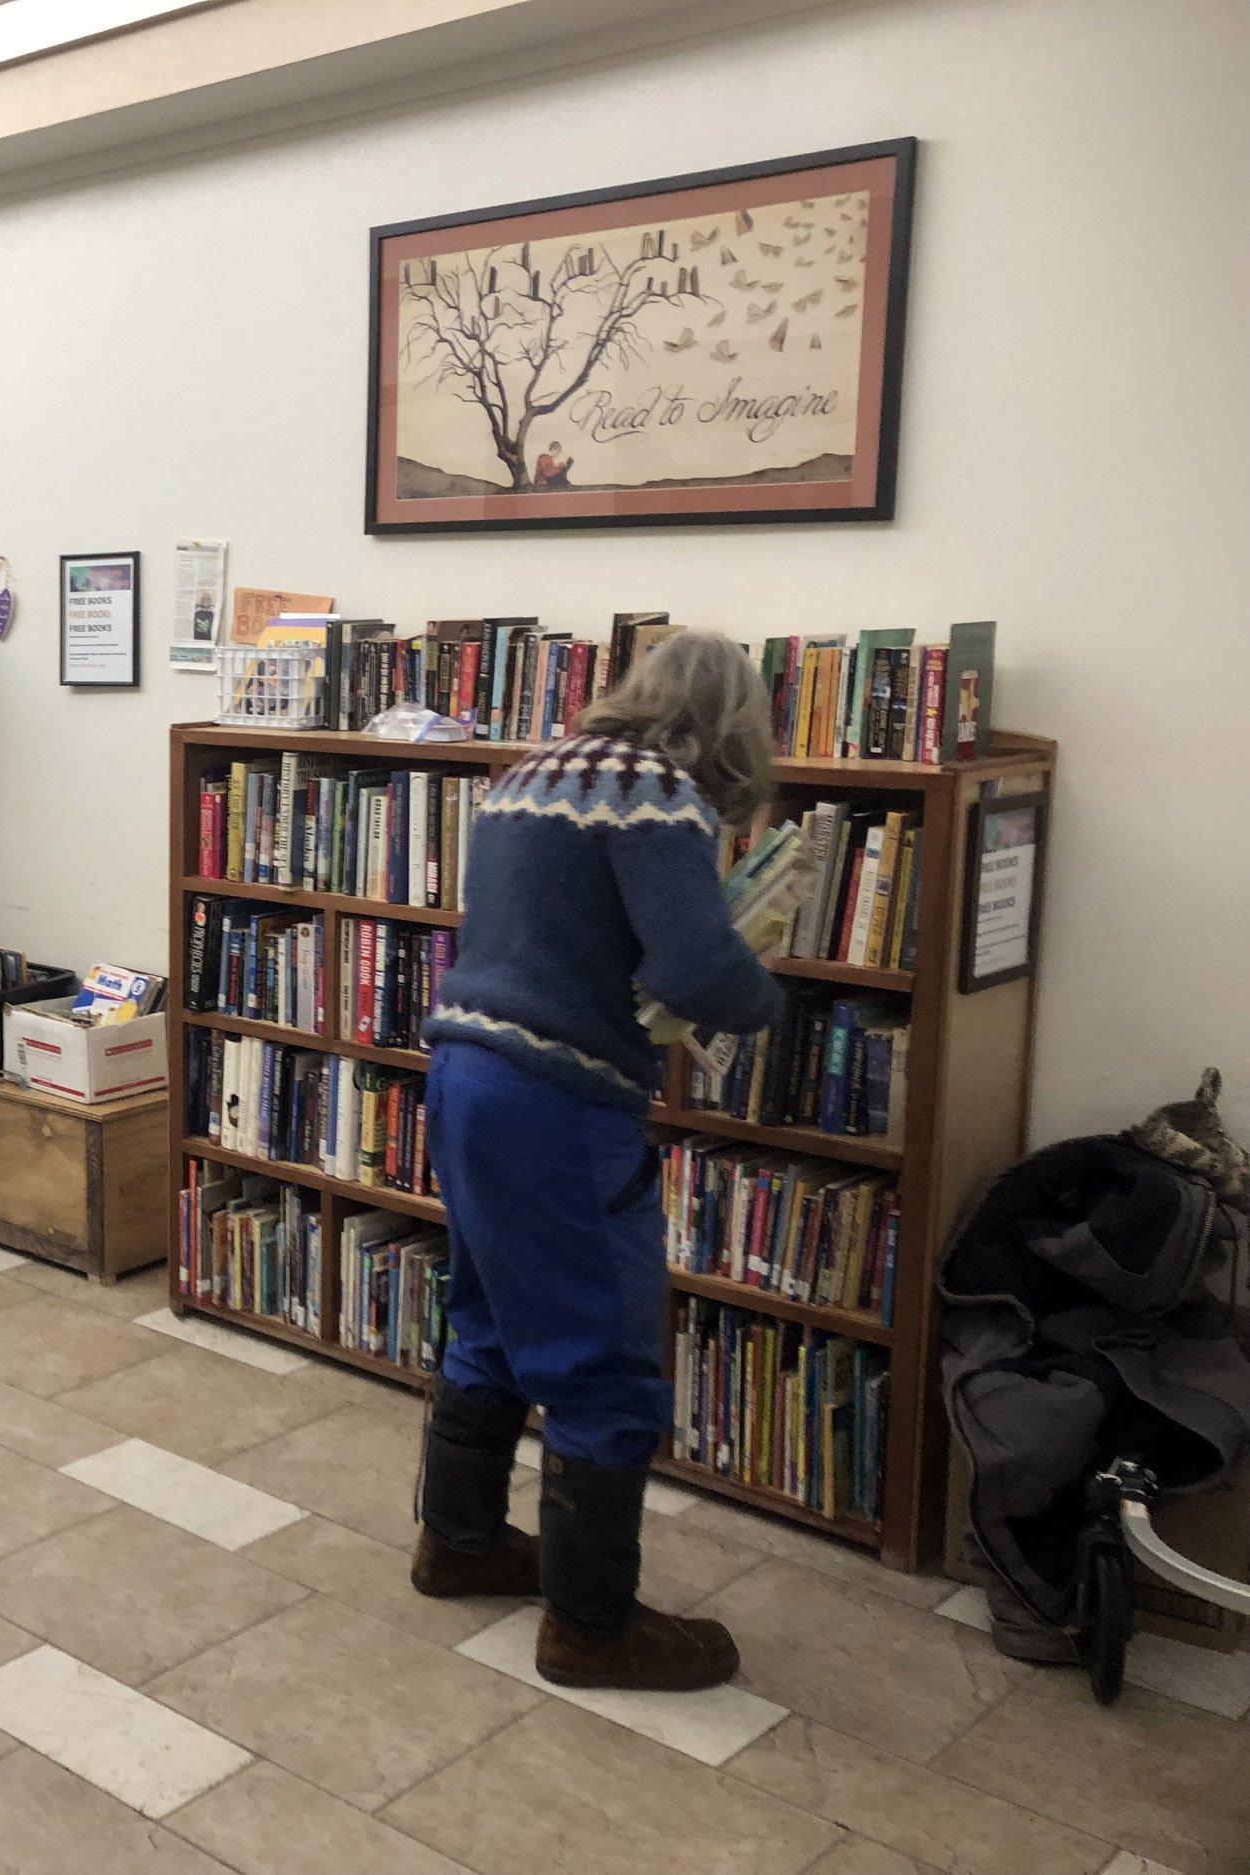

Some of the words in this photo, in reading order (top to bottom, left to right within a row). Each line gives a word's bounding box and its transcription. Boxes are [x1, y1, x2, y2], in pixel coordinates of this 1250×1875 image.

[569, 384, 662, 443] Read
[658, 384, 698, 426] to
[697, 376, 839, 443] Imagine
[69, 597, 86, 606] FREE
[88, 596, 112, 605] BOOKS
[241, 592, 291, 616] FREE
[88, 624, 112, 632] BOOKS
[237, 614, 270, 636] BO
[373, 817, 382, 840] TAYLOR
[304, 822, 314, 863] Alaska
[360, 924, 372, 958] ROBIN
[376, 924, 386, 938] THE
[97, 973, 123, 991] Math
[360, 960, 371, 986] COOK
